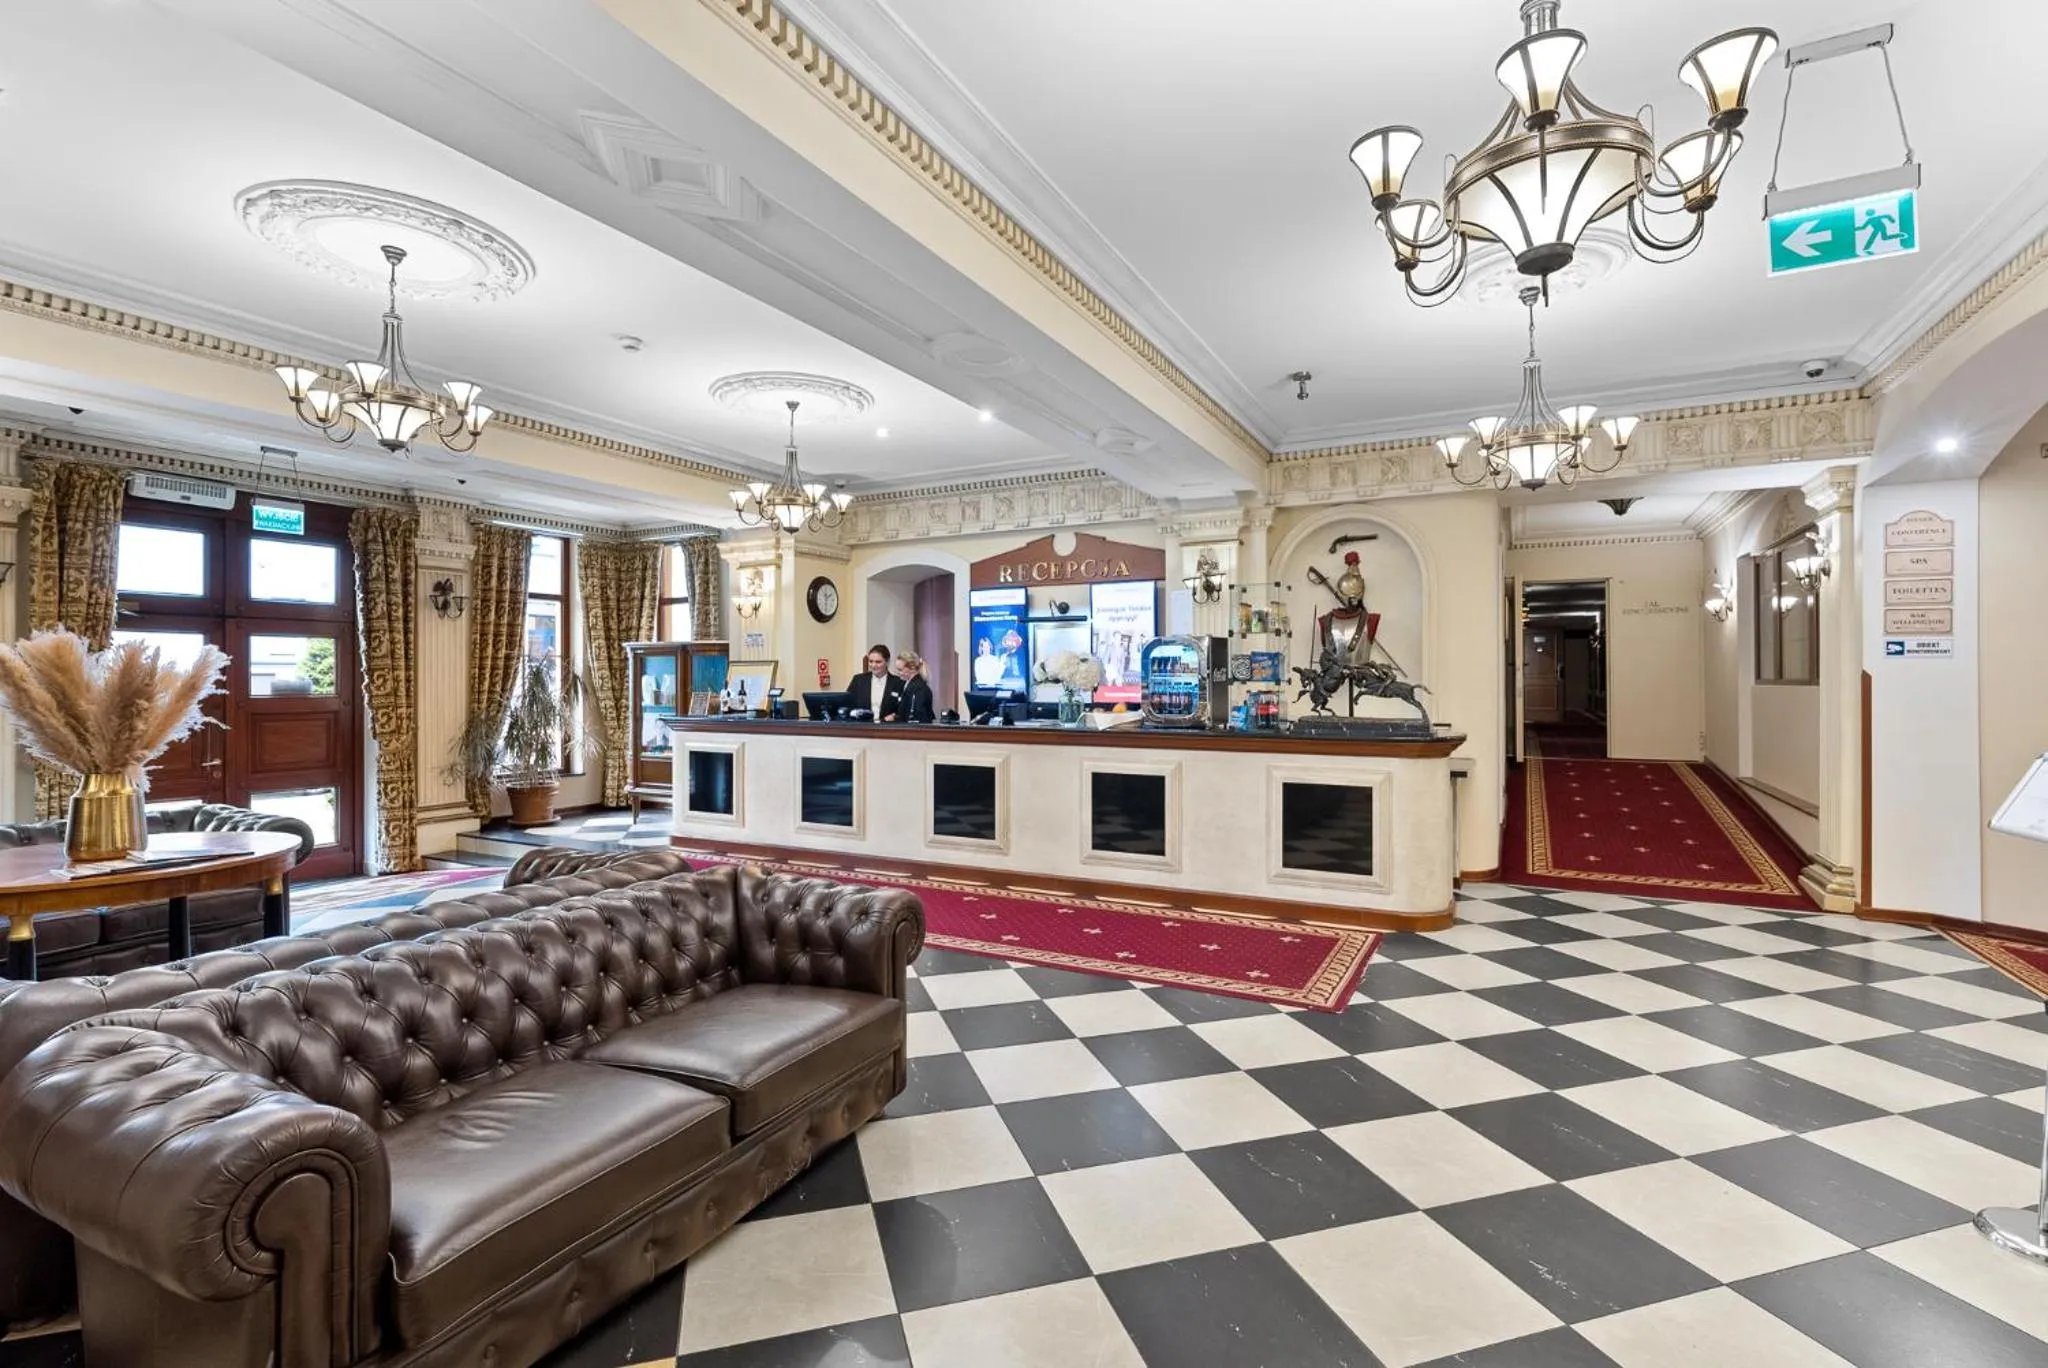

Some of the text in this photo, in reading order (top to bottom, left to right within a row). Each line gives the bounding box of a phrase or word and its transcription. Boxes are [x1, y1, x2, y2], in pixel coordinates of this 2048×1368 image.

[1910, 557, 1928, 565] SPA
[999, 559, 1131, 583] RECEPCJA
[1892, 586, 1947, 595] TOILETTES
